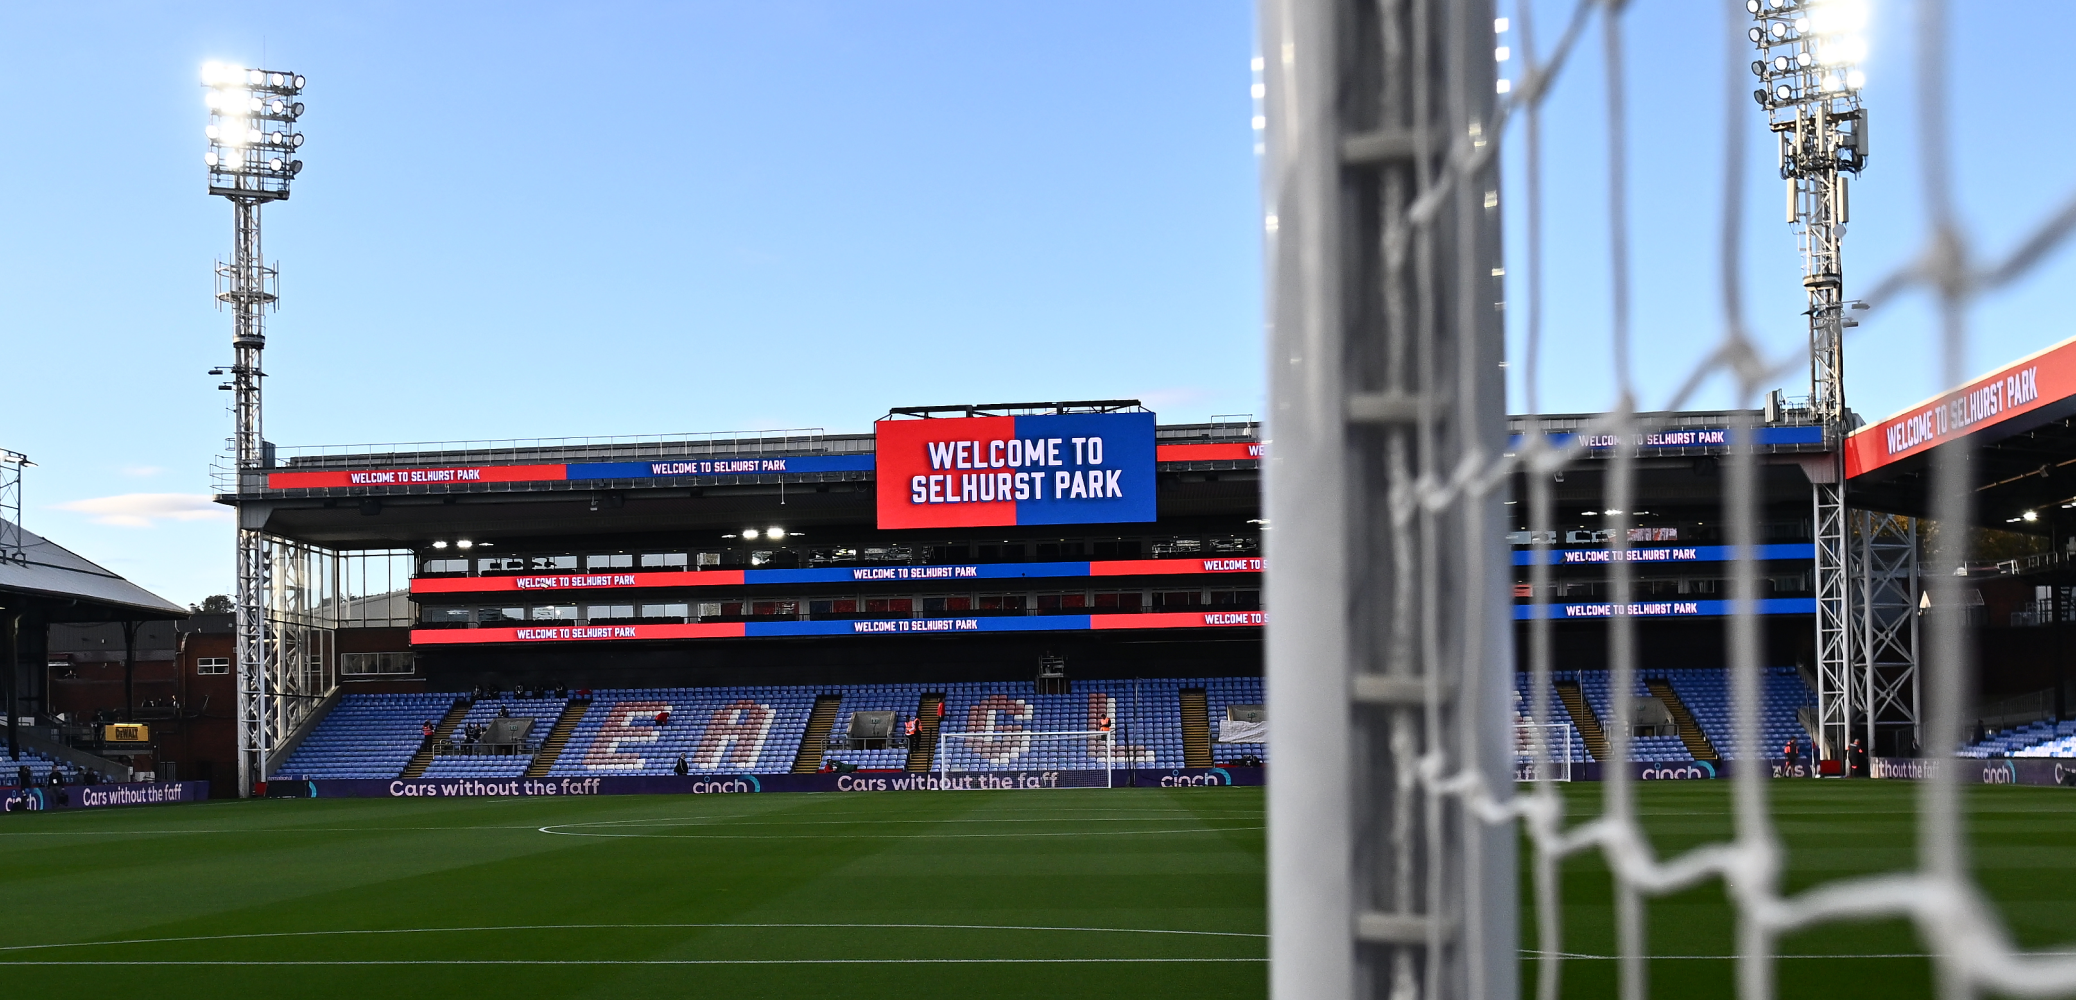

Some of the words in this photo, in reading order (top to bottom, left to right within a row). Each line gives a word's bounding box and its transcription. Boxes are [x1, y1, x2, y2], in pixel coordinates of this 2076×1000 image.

[1886, 411, 1933, 454] WELCOME
[1935, 405, 1947, 436] TO
[1951, 381, 2003, 430] SELHURST
[2007, 366, 2038, 408] PARK
[1579, 434, 1626, 447] WELCOM
[1647, 432, 1695, 445] SELHURST
[1698, 431, 1724, 443] PARK
[927, 438, 1062, 470] WELCOME
[1071, 437, 1103, 466] TO
[651, 463, 697, 474] WELCOME
[700, 462, 711, 473] TO
[714, 461, 759, 472] SELHURST
[762, 460, 786, 471] PARK
[351, 472, 395, 484] WELCOME
[397, 471, 408, 482] TO
[411, 470, 455, 481] SELHURST
[457, 469, 480, 480] PARK
[911, 472, 1045, 504] SELHURST
[1055, 469, 1123, 499] PARK
[1565, 551, 1609, 562] WELCOME
[1612, 550, 1623, 561] TO
[1626, 549, 1670, 560] SELHURST
[1673, 548, 1696, 560] PARK
[853, 568, 896, 579] WELCOME
[898, 568, 909, 578] TO
[911, 567, 952, 578] SELHURST
[954, 566, 977, 577] PARK
[1203, 559, 1247, 571] WELCOME
[1249, 559, 1260, 570] TO
[516, 577, 557, 588] WELCOME
[559, 577, 569, 587] TO
[572, 575, 612, 586] SELHURST
[614, 575, 635, 585] PARK
[1566, 605, 1610, 616] WELCOME
[1613, 604, 1625, 615] TO
[1627, 603, 1671, 615] SELHURST
[1674, 603, 1697, 614] PARK
[854, 621, 896, 632] WELCOME
[898, 620, 909, 631] TO
[911, 619, 954, 631] SELHURST
[956, 619, 978, 630] PARK
[1204, 613, 1248, 625] WELCOME
[1250, 613, 1262, 624] TO
[517, 629, 557, 639] WELCOME
[559, 628, 570, 639] TO
[572, 627, 612, 638] SELHURST
[614, 627, 636, 637] PARK
[1642, 762, 1702, 780] cinch
[1908, 759, 1923, 778] the
[1983, 761, 2010, 784] cinch
[693, 776, 748, 794] cinch
[837, 775, 887, 792] Cars
[892, 774, 973, 791] without
[978, 774, 1013, 790] the
[1018, 772, 1058, 790] faff
[1160, 769, 1218, 788] cinch
[83, 787, 107, 806] Cars
[110, 785, 146, 805] without
[147, 784, 163, 802] the
[165, 783, 183, 800] faff
[389, 780, 436, 797] Cars
[441, 779, 519, 797] without
[524, 780, 557, 796] the
[561, 778, 600, 795] faff
